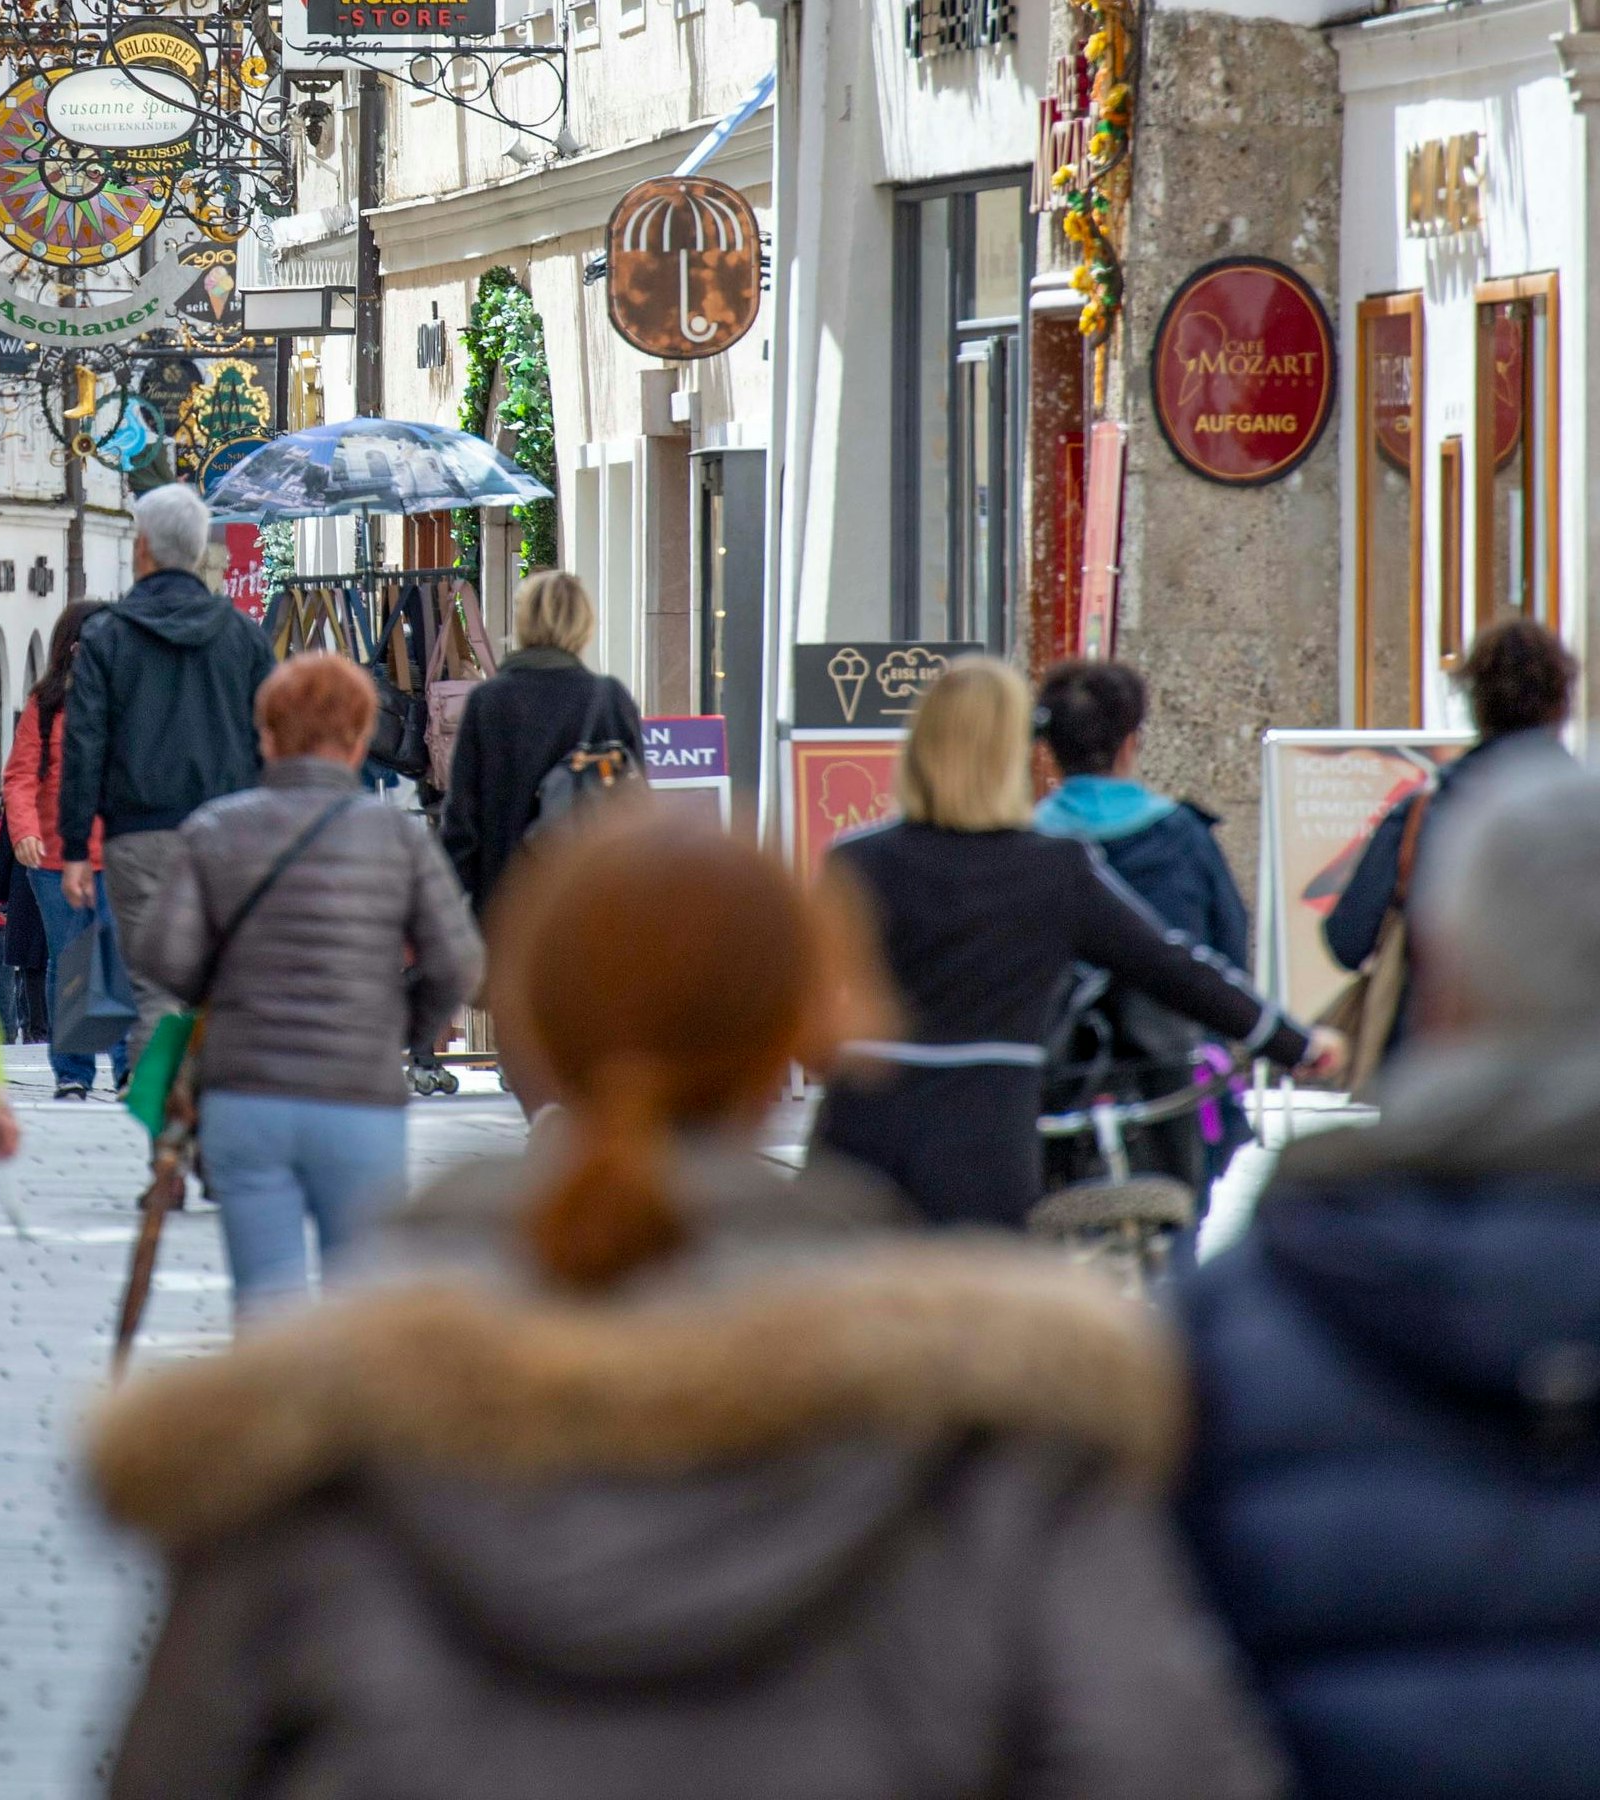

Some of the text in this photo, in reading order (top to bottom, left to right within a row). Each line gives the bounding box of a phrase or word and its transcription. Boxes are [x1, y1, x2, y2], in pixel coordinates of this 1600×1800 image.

[113, 37, 195, 65] CHLOSSEREI
[59, 102, 134, 116] susanne
[72, 121, 177, 132] TRACHTENKINDER
[186, 301, 209, 312] seit
[1198, 350, 1318, 375] MOZART
[1194, 414, 1298, 433] AUFGANG
